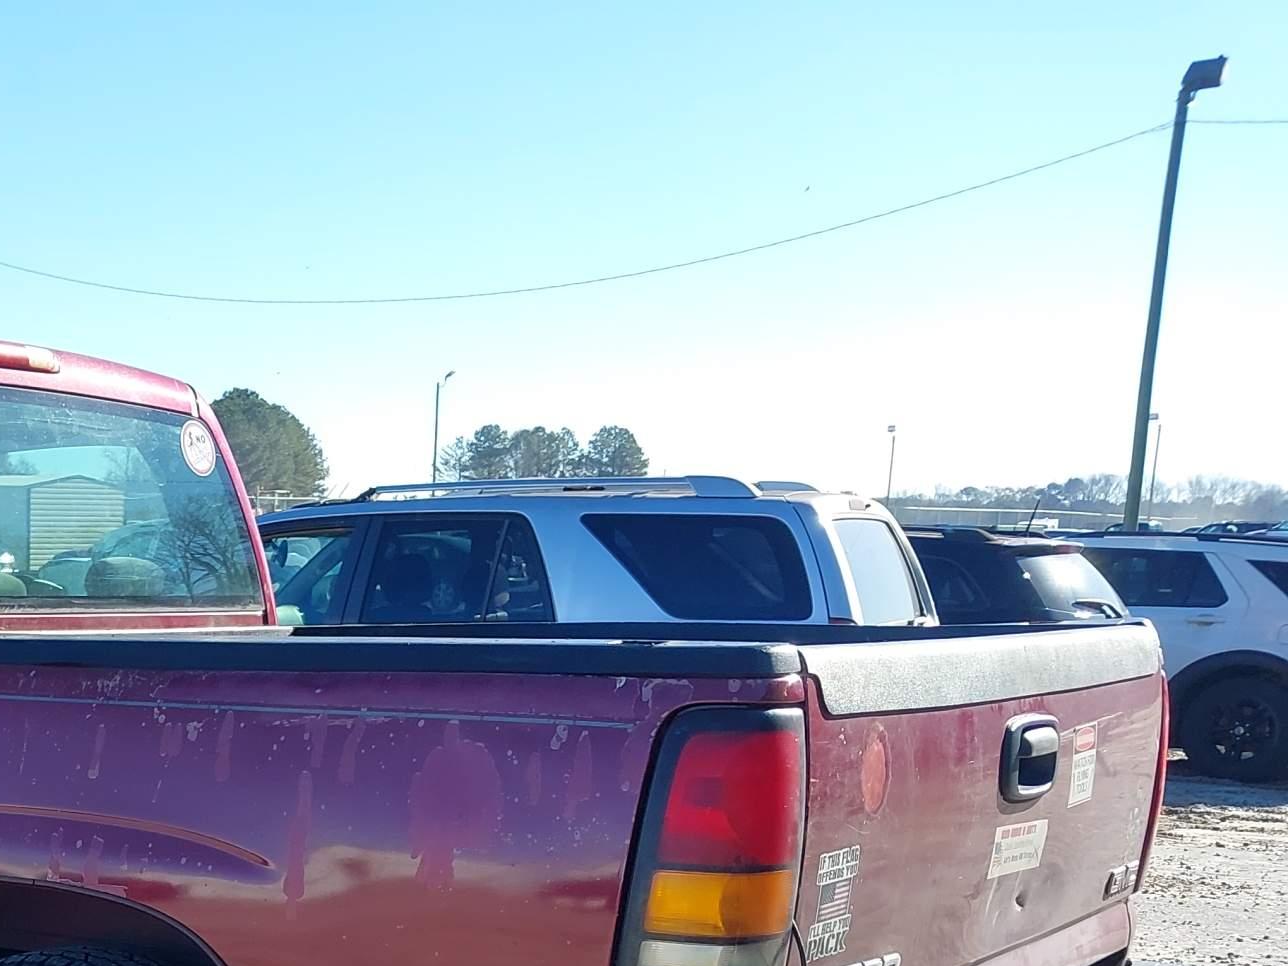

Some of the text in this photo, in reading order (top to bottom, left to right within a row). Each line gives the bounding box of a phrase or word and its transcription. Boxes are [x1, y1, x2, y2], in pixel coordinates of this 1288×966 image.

[827, 852, 841, 869] THIS
[841, 847, 859, 866] FLAG
[818, 863, 858, 884] OFFENDS YOU
[821, 920, 836, 935] HELP
[806, 930, 846, 961] PACK
